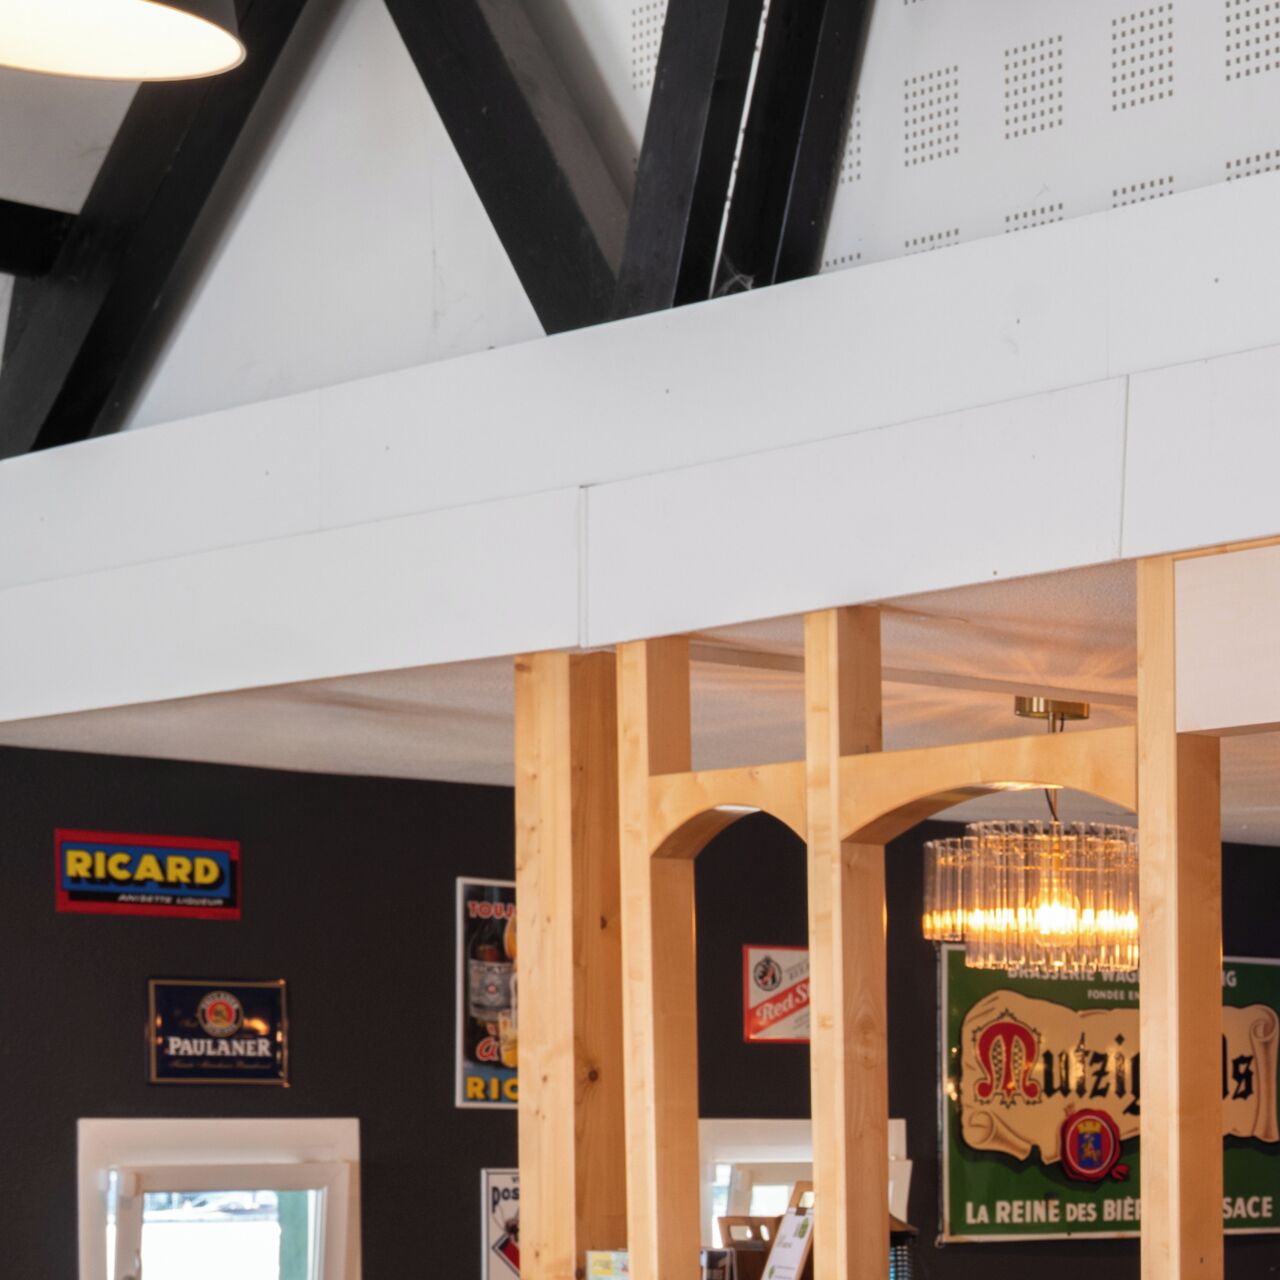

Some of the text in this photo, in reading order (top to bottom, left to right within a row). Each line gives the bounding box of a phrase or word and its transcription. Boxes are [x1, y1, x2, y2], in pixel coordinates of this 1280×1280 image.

[66, 849, 220, 884] RICARD
[467, 900, 516, 919] TOUJ
[167, 1036, 272, 1057] PAULANER
[466, 1076, 518, 1100] RIC
[492, 1187, 519, 1212] pos
[965, 1201, 988, 1224] LA
[996, 1199, 1060, 1224] REINE
[1066, 1202, 1097, 1222] DES
